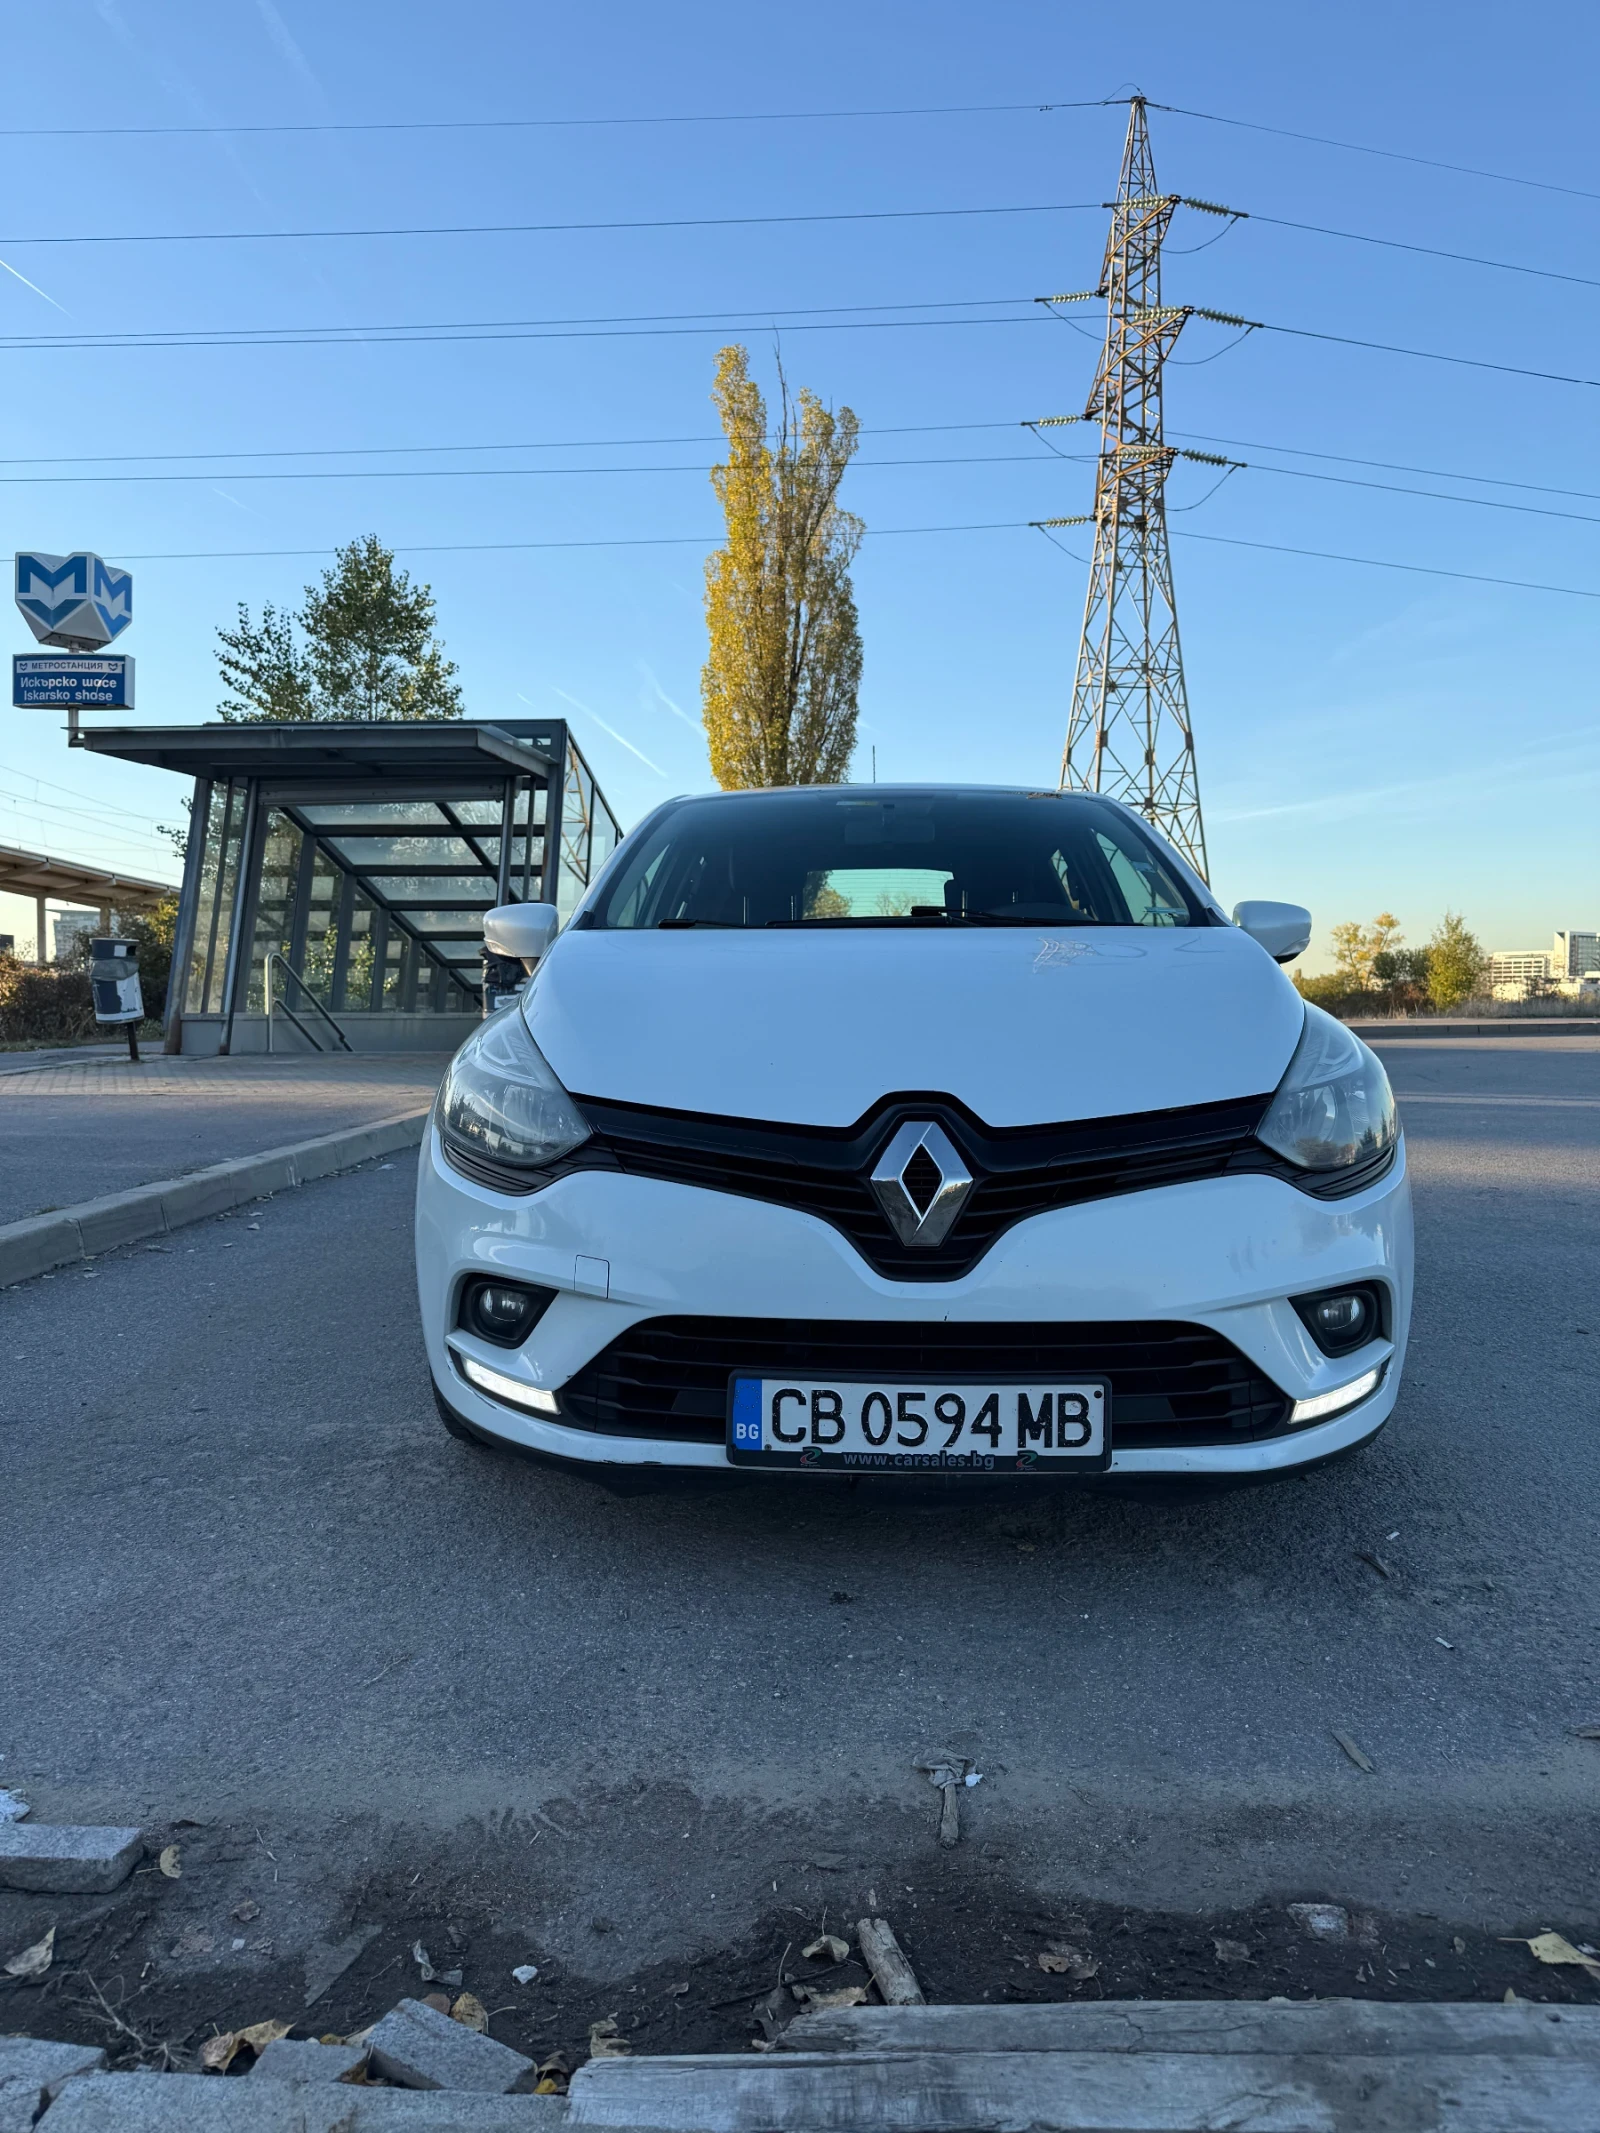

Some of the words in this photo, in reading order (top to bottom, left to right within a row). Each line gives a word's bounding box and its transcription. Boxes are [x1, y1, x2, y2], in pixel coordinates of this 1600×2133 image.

[31, 662, 103, 670] МЕТРОСТАНЦИЯ
[20, 676, 78, 689] Искърско
[81, 679, 118, 688] шосе
[24, 690, 71, 701] Iskarsko
[74, 690, 113, 701] shose
[771, 1388, 846, 1445] CB
[860, 1391, 1003, 1449] 0594
[1017, 1392, 1093, 1449] MB
[735, 1422, 759, 1440] BG
[843, 1452, 995, 1471] www.carsales.bg
